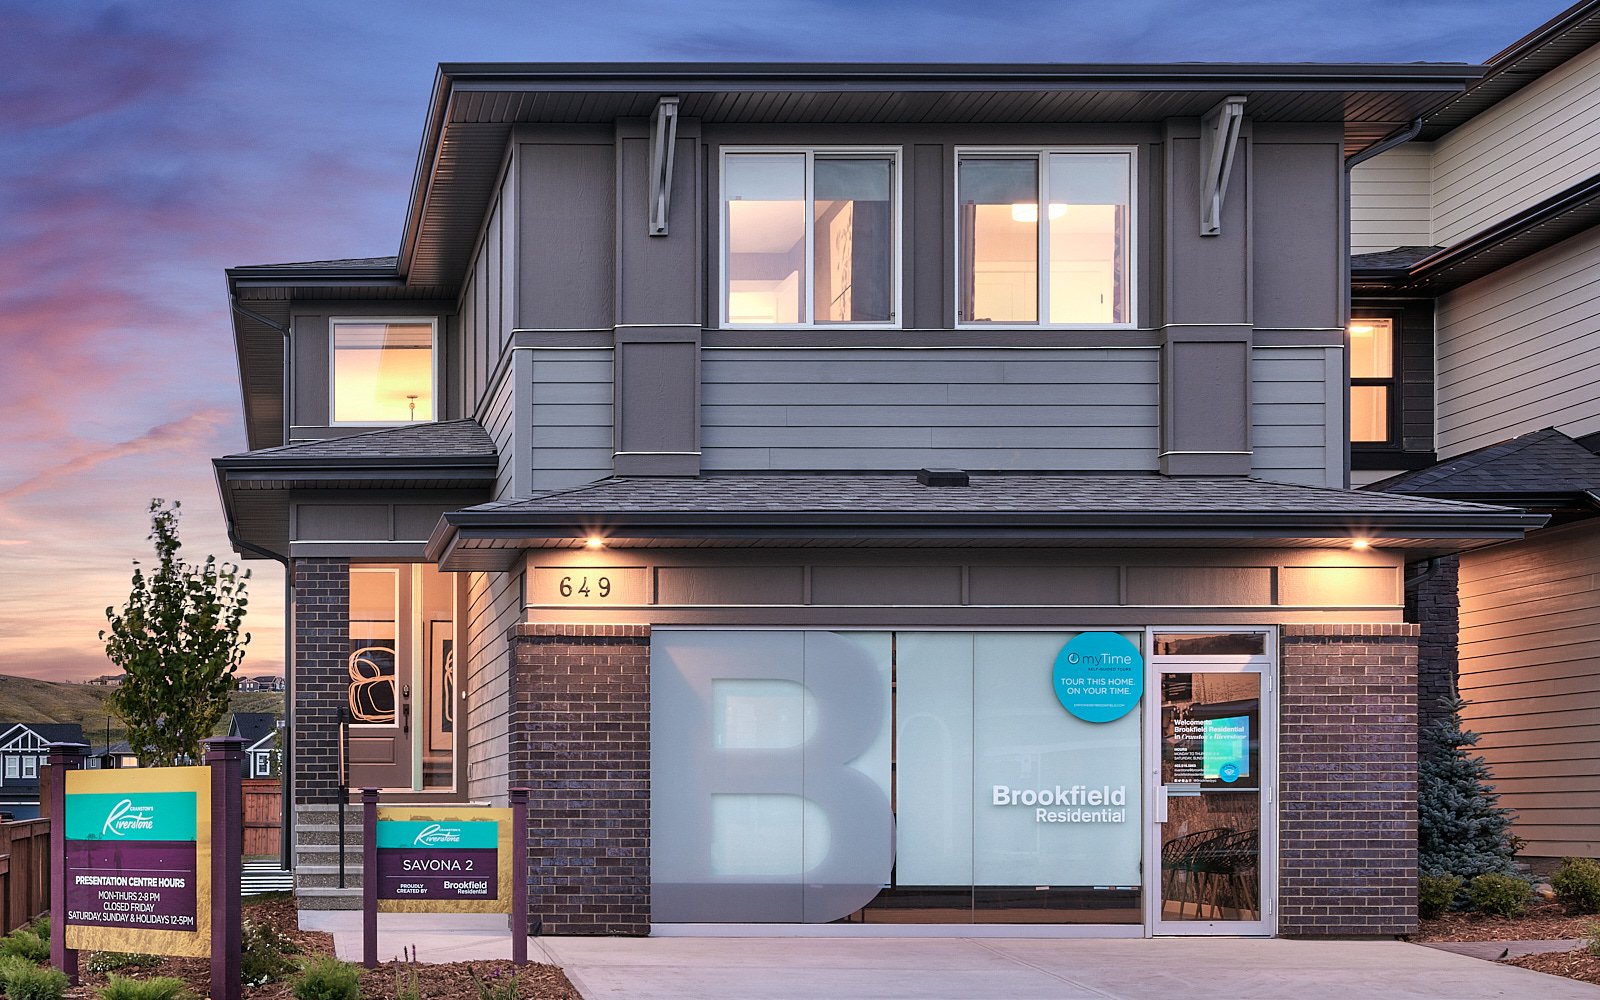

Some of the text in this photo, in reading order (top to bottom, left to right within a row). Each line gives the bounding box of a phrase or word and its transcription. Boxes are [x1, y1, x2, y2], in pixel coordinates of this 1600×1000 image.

[560, 577, 610, 597] 649
[1083, 653, 1131, 666] myTime
[1108, 678, 1135, 686] HOME.
[993, 785, 1126, 805] Brookfield
[102, 799, 154, 836] Riverstone
[1036, 809, 1126, 822] Residential
[413, 824, 461, 846] Riverstone
[403, 860, 474, 871] SAVONA 2
[75, 876, 186, 888] PRESENTATION CENTRE HOURS
[443, 880, 488, 890] Brookfield
[98, 891, 160, 901] MON-THURS 2-8 PM
[103, 902, 155, 912] CLOSED FRIDAY
[68, 911, 194, 925] SATURDAY, SUNDAY & HOLIDAYS 12-5PM
